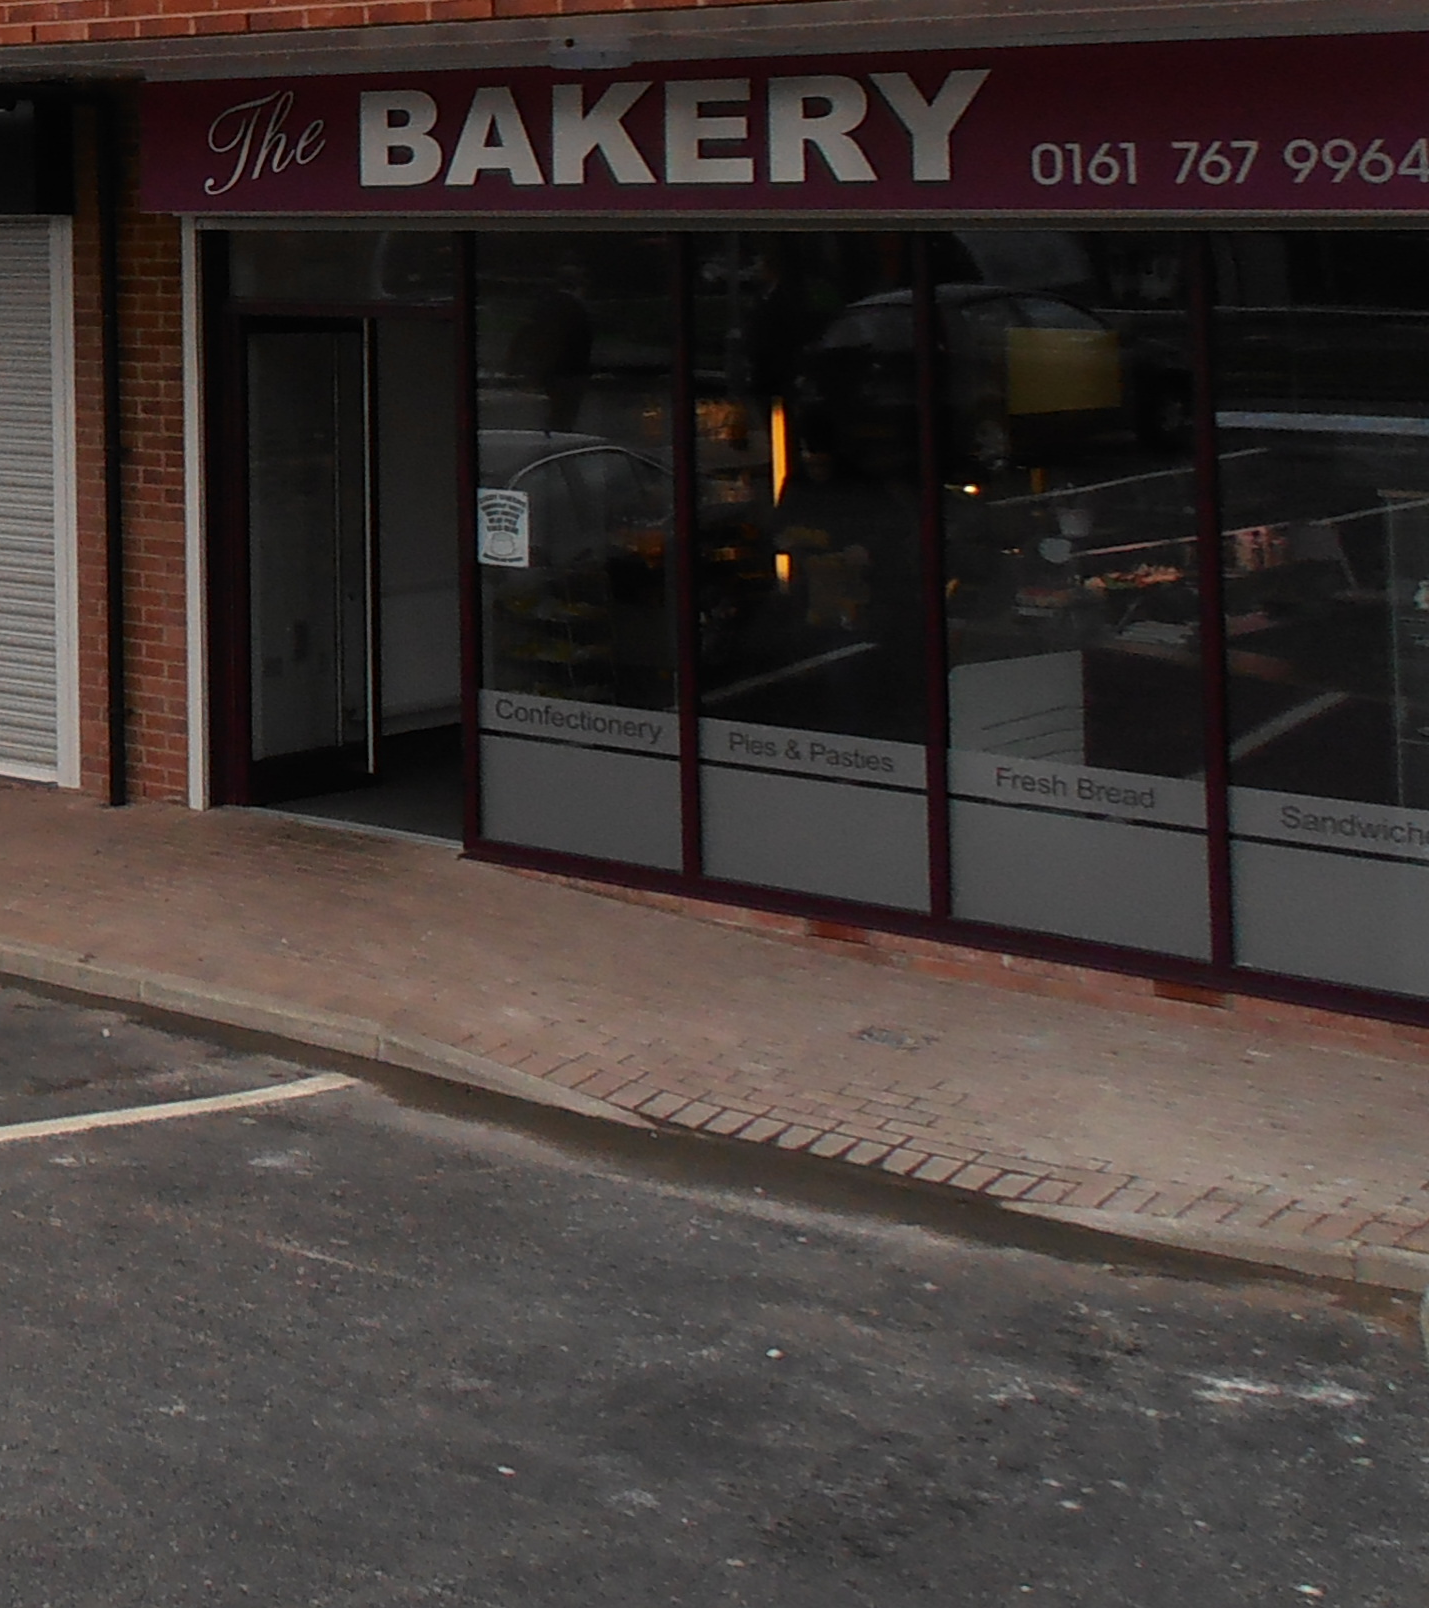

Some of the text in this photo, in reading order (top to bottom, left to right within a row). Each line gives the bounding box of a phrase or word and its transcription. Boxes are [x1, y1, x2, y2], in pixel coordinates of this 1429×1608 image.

[205, 68, 992, 196] The BAKERY
[1030, 137, 1429, 186] 0161 767 9964
[495, 698, 662, 745] Confectionery
[729, 731, 894, 773] Pies & Pasties
[996, 767, 1155, 809] Fresh Bread
[1280, 805, 1429, 846] Sandwich
